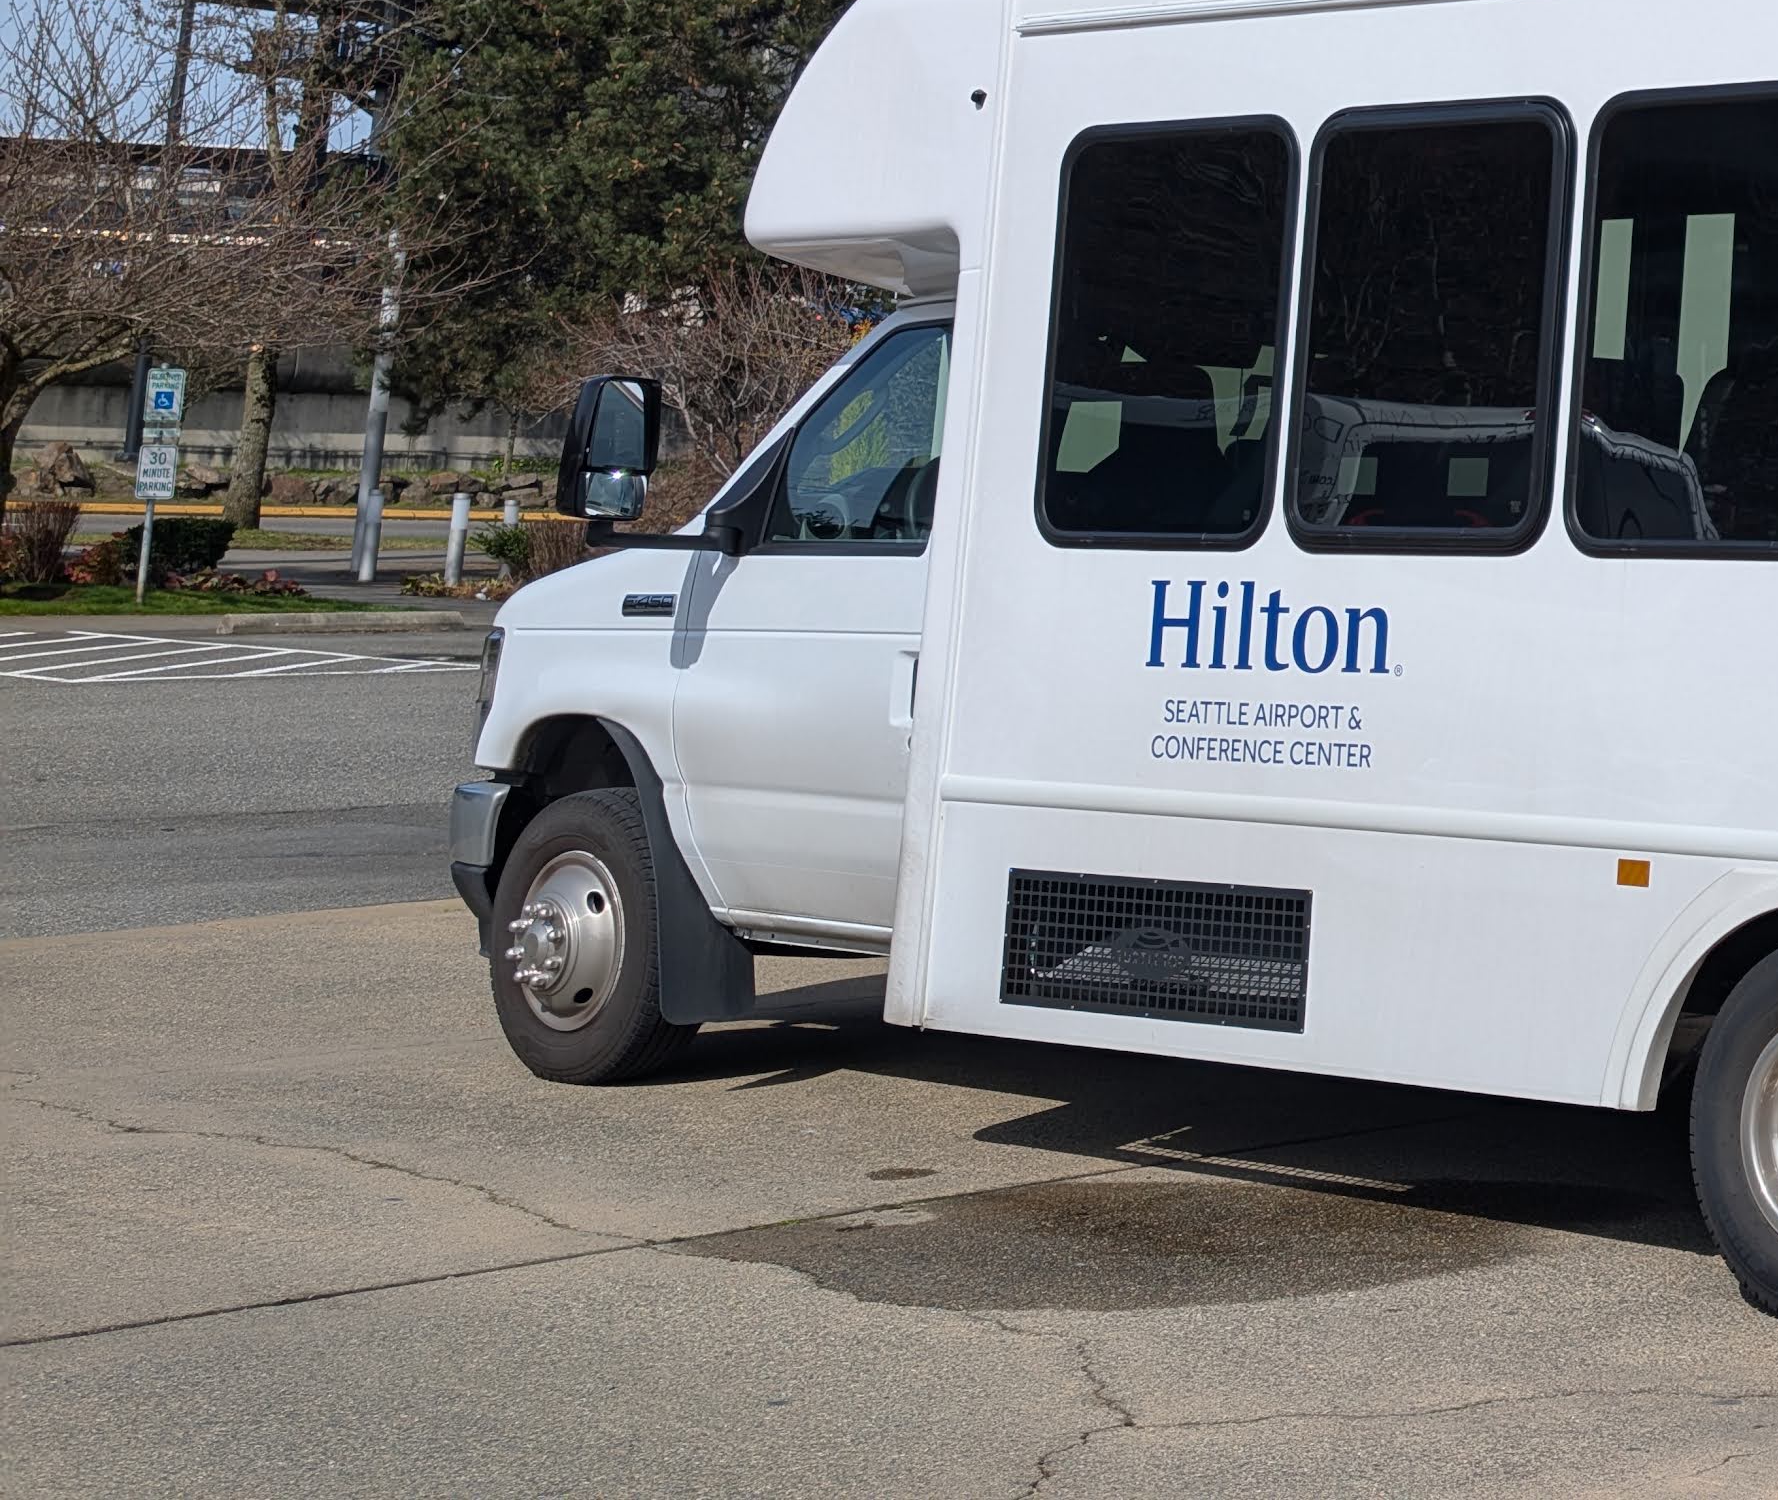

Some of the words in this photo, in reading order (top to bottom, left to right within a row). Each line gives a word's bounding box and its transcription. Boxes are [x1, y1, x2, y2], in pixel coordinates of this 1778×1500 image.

[151, 382, 180, 390] PARKING
[149, 452, 167, 465] 30
[142, 467, 171, 478] MINUTE
[138, 481, 172, 492] PARKING
[1164, 699, 1249, 726] SEATTLE
[1253, 702, 1344, 730] AIRPORT
[1348, 706, 1362, 730] &
[1151, 735, 1285, 764] CONFERENCE
[1289, 741, 1372, 768] CENTER
